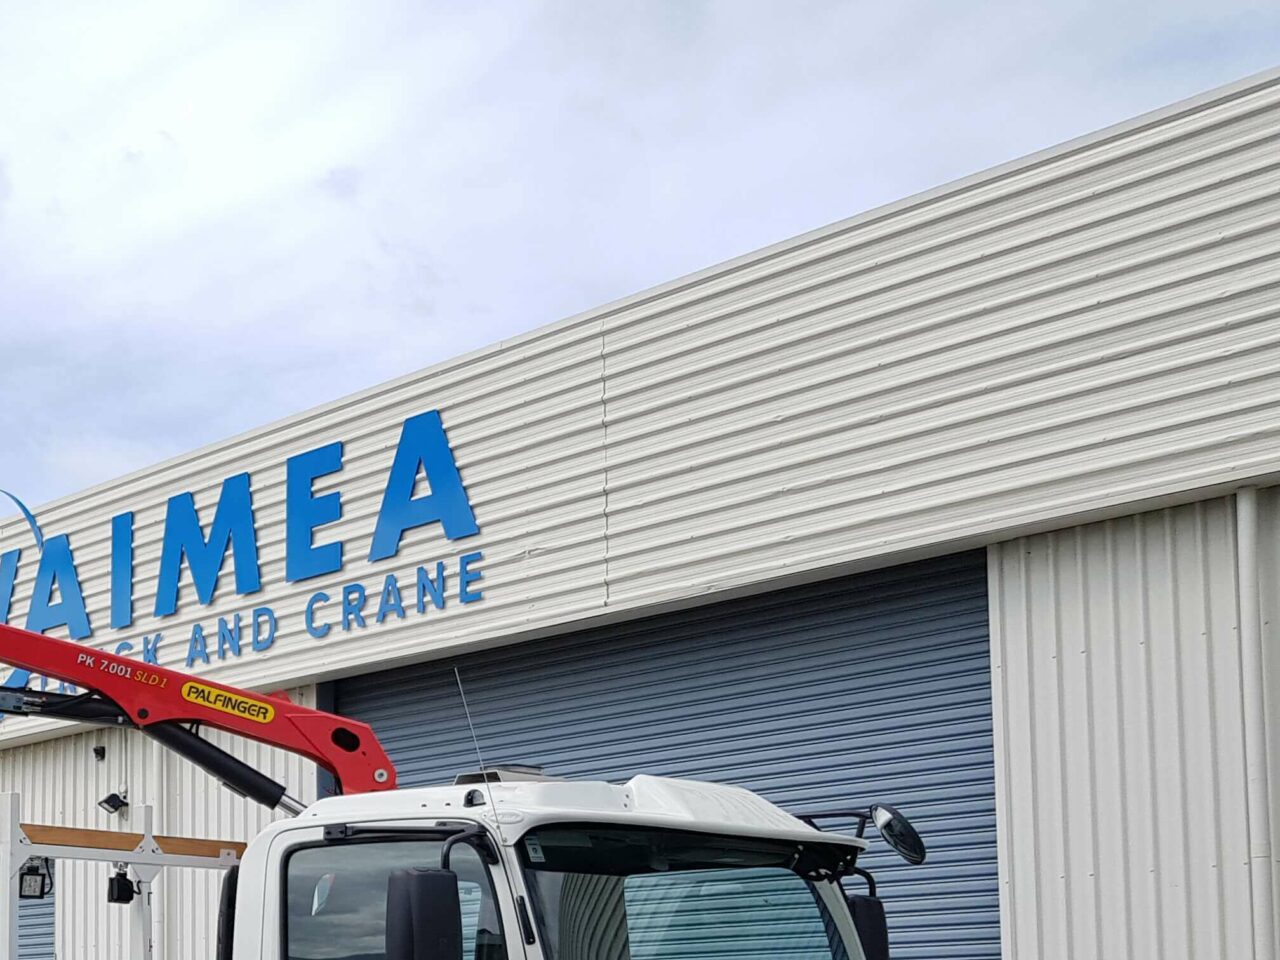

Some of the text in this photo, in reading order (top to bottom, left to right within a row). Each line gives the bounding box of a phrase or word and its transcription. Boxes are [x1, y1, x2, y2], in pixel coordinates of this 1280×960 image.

[185, 606, 277, 667] AND
[305, 551, 484, 638] CRANE
[77, 653, 95, 668] PK
[99, 660, 132, 679] 7.001
[186, 685, 270, 721] PALFINGER
